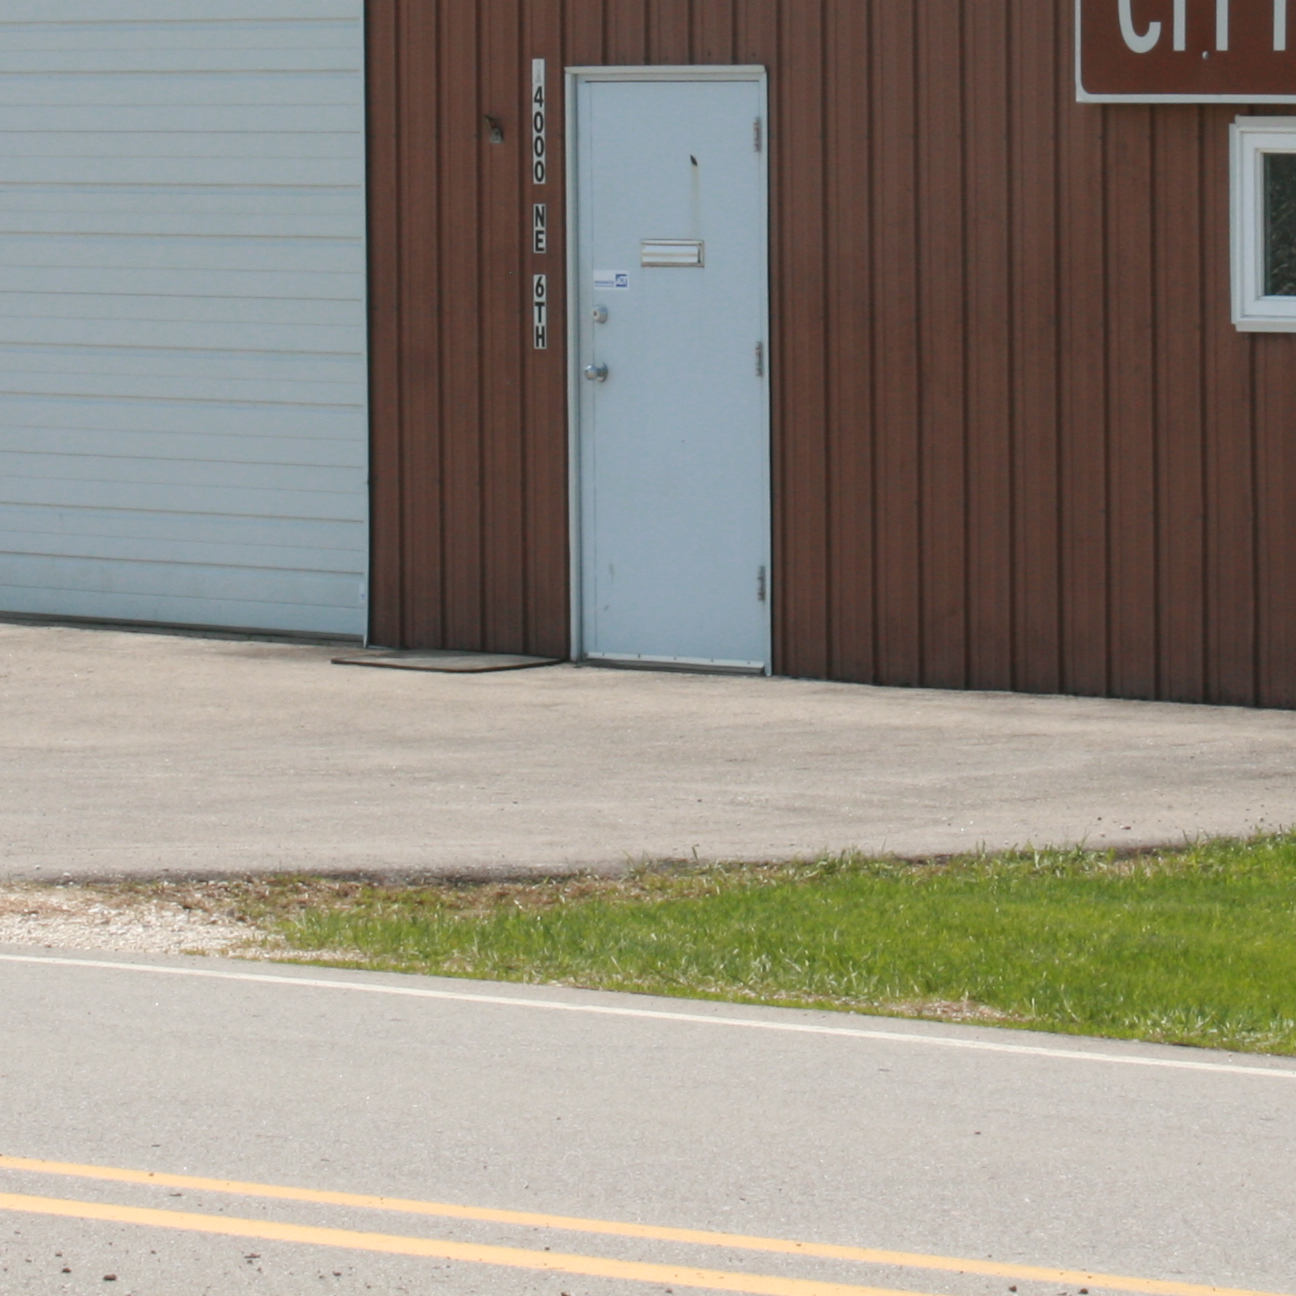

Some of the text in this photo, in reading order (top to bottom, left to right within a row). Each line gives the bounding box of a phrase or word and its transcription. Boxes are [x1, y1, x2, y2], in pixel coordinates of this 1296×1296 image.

[533, 85, 545, 348] 4000 NE 6TH
